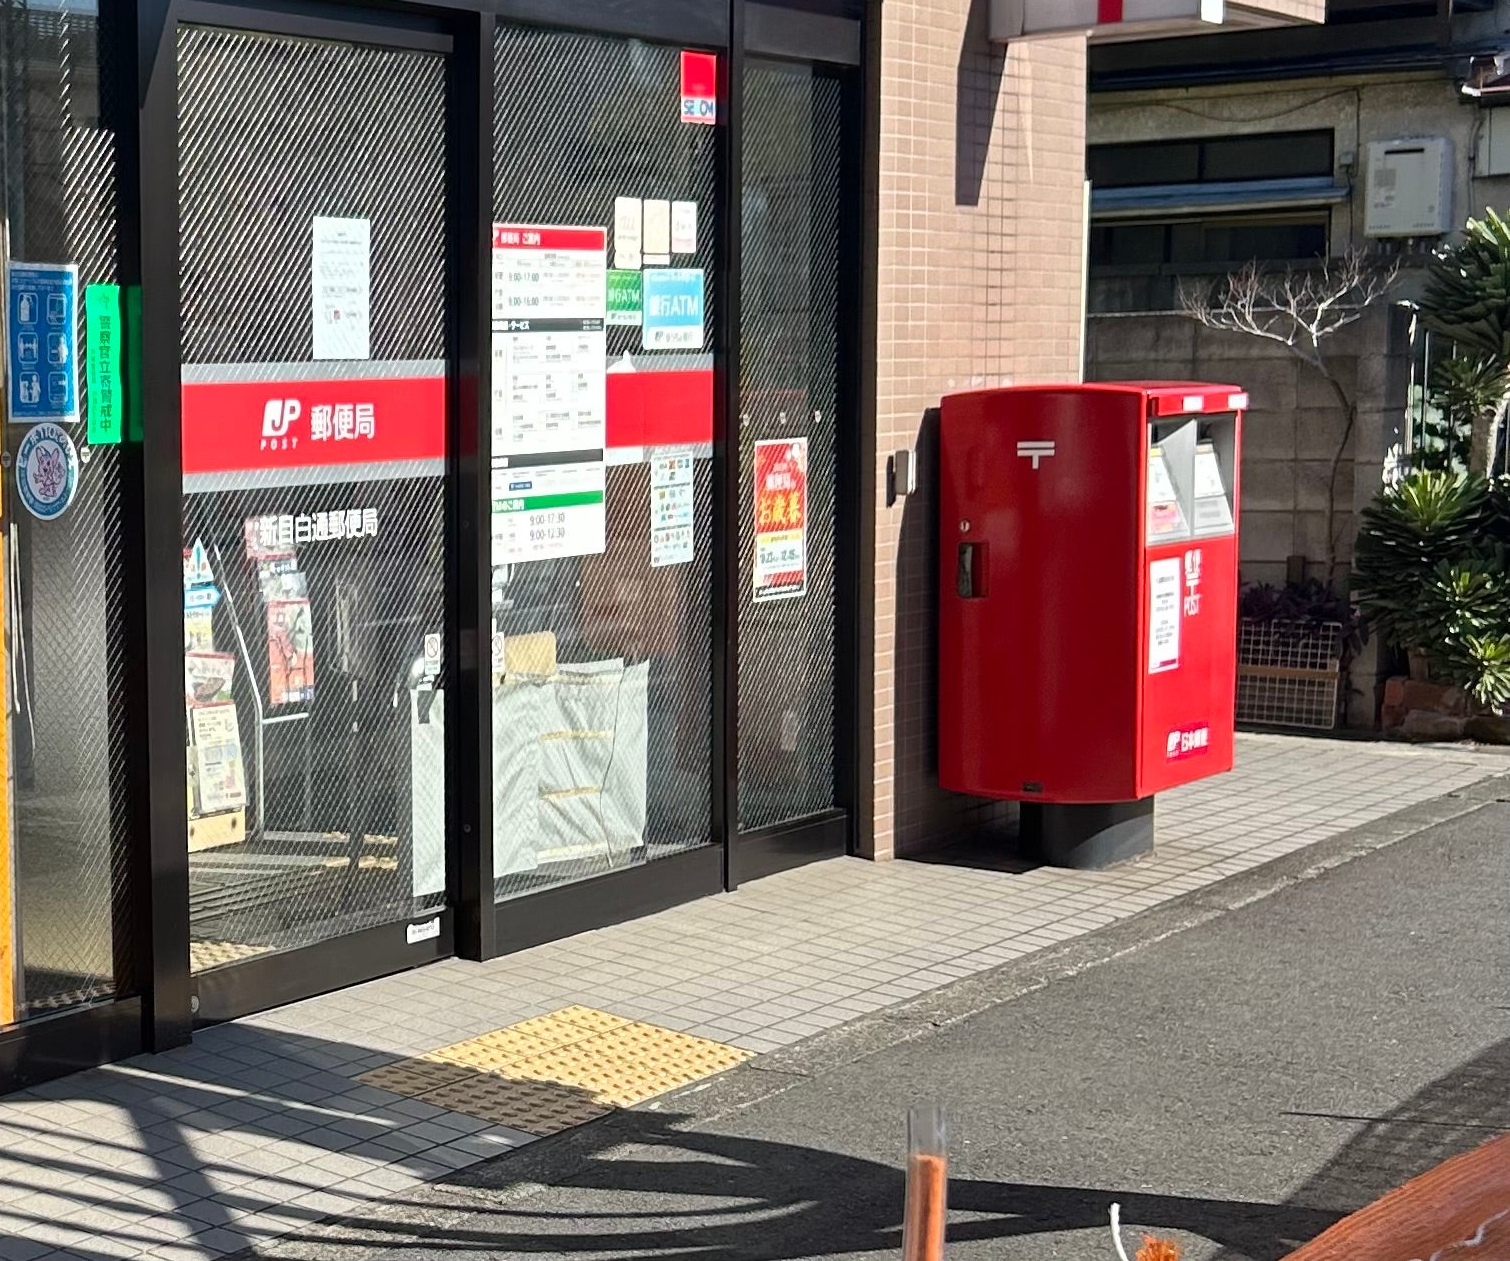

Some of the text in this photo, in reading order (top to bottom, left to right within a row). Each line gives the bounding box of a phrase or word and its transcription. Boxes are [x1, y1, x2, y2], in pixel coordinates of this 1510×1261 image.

[310, 403, 376, 441] 郵便局
[259, 436, 298, 452] POST
[258, 507, 378, 547] 新目白通郵便局
